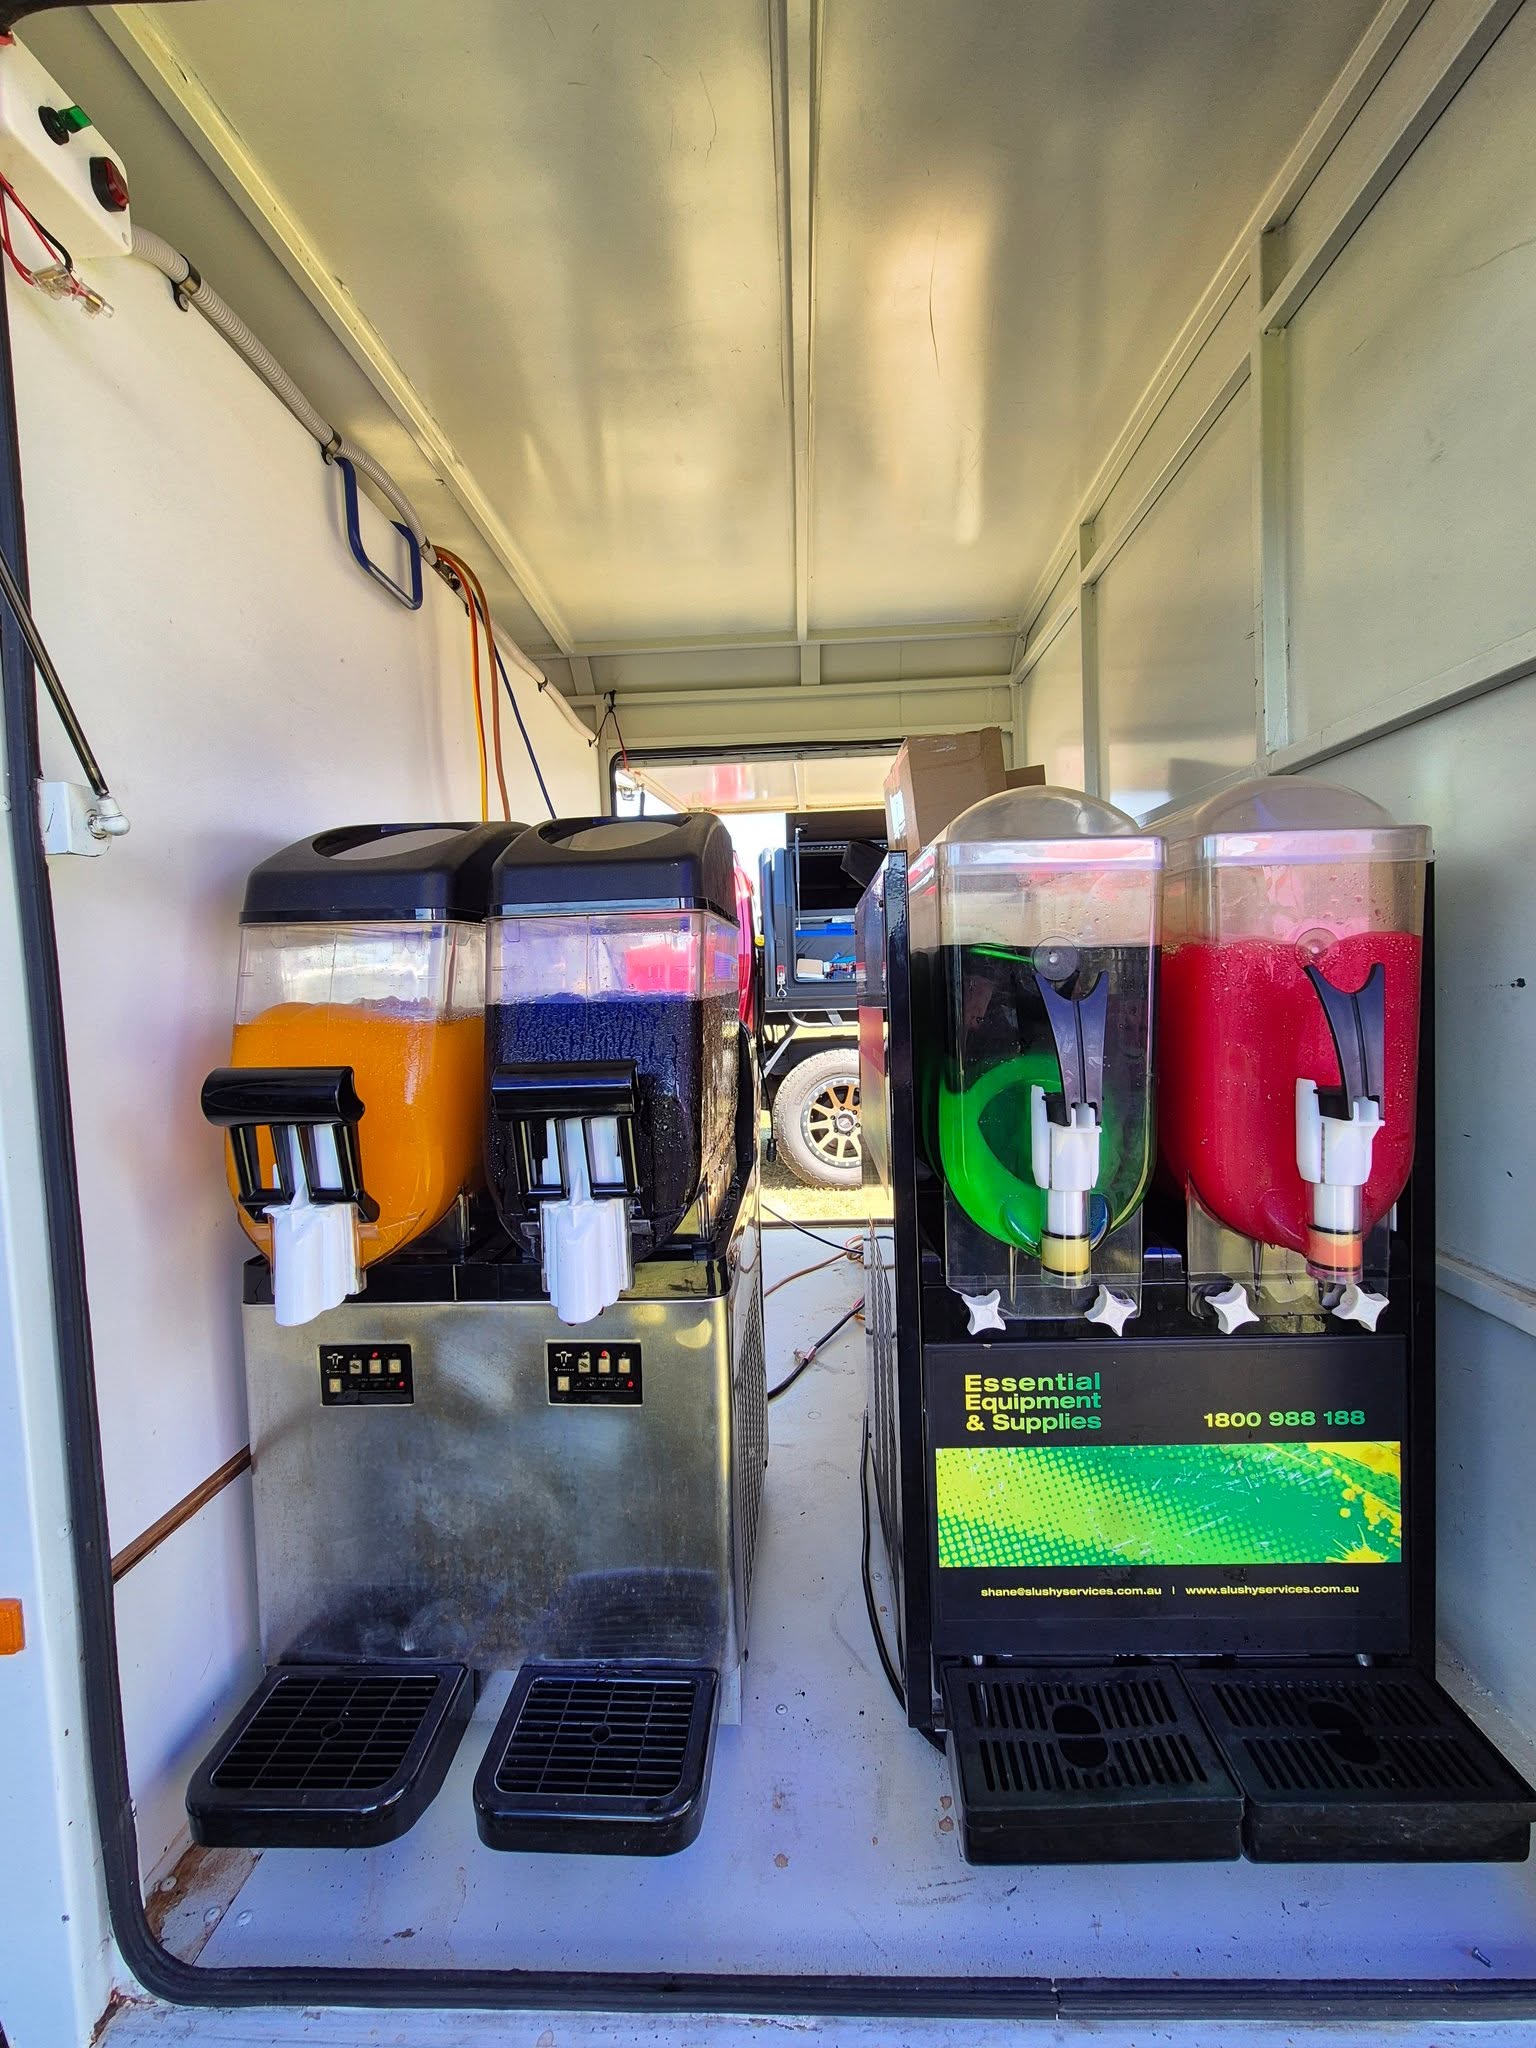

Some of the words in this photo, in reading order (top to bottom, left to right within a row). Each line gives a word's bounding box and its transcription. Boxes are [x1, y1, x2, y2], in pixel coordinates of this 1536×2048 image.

[964, 1372, 1101, 1392] Essential
[964, 1392, 1102, 1414] Equipment
[965, 1414, 986, 1432] &
[992, 1412, 1102, 1434] Supplies
[1203, 1411, 1262, 1430] 1800
[1268, 1409, 1316, 1429] 988
[1323, 1409, 1366, 1427] 188
[980, 1586, 1163, 1599] shane@slushyservices.com.au
[1184, 1584, 1360, 1598] www.slushyservices.com.au
